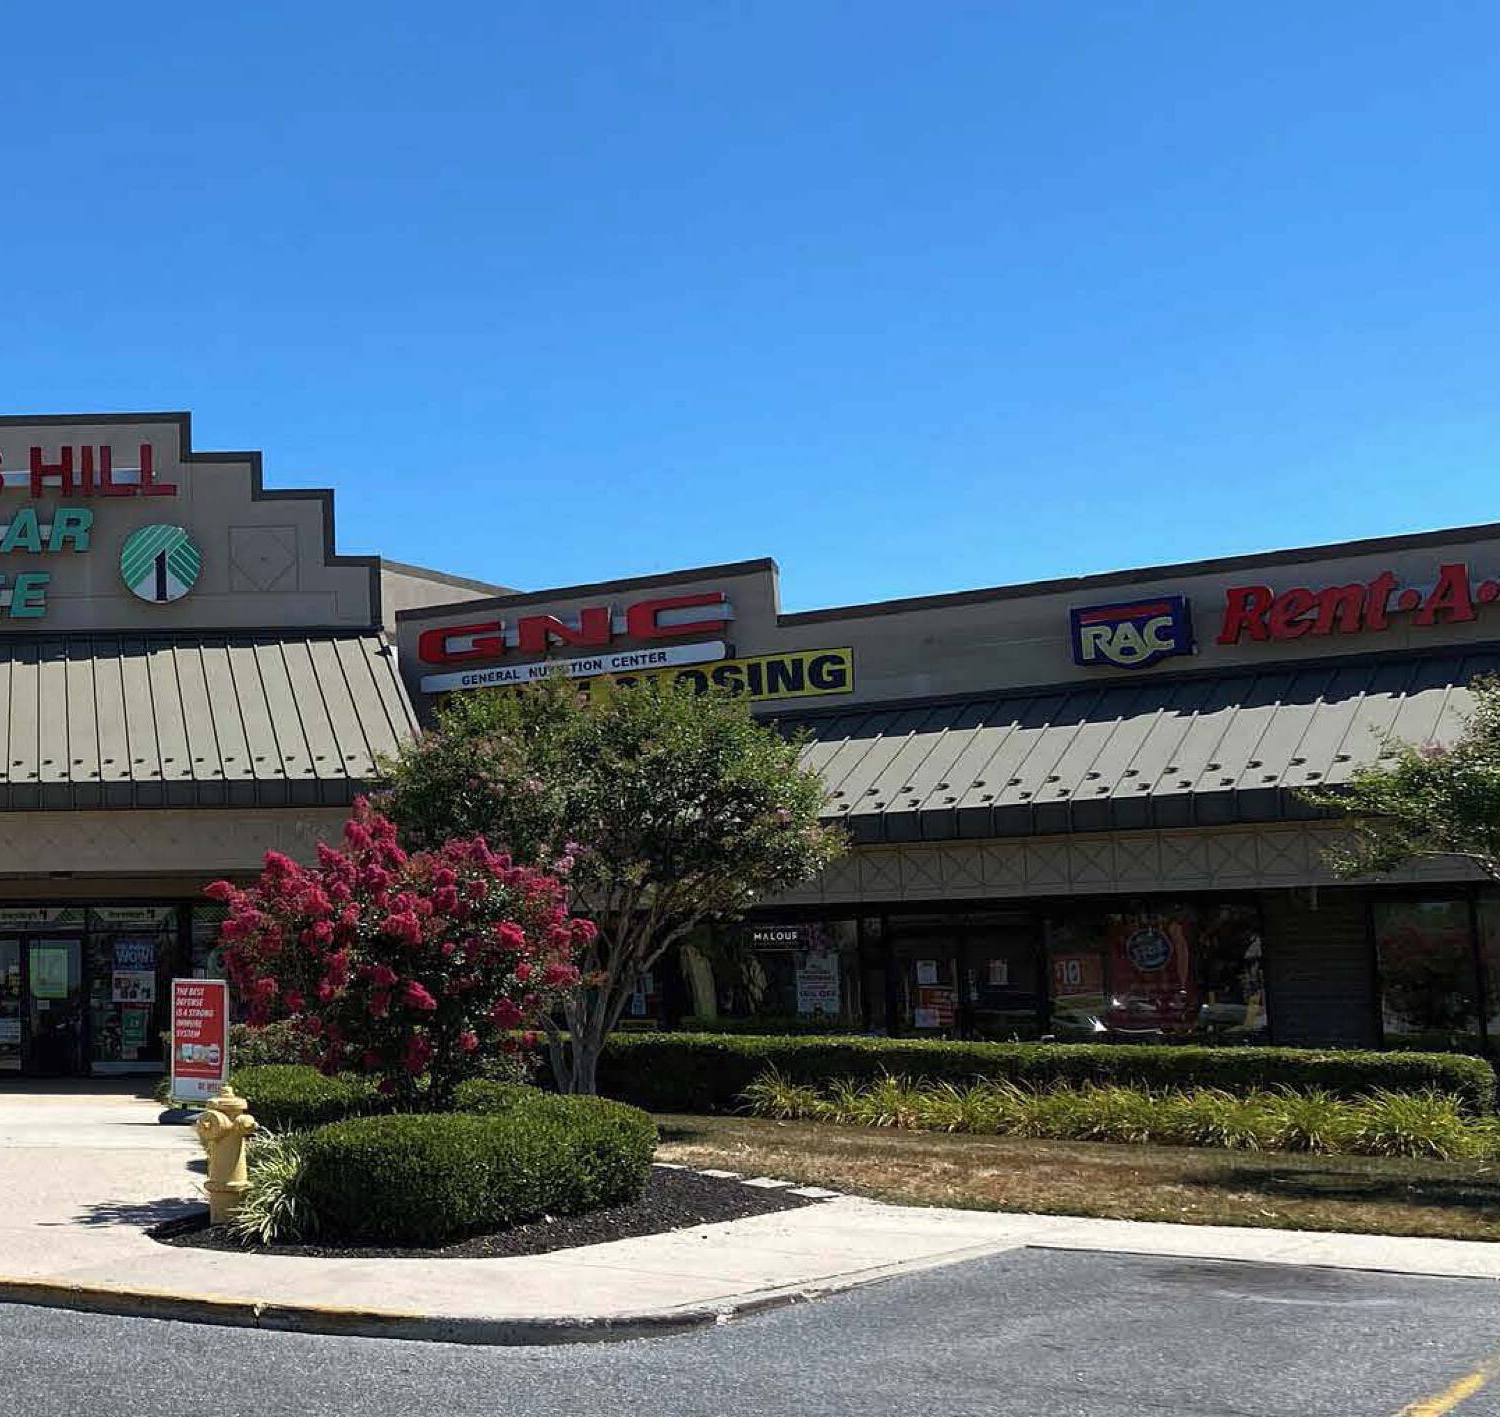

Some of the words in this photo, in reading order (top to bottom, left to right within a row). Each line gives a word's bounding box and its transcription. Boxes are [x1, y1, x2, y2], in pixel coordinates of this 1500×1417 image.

[30, 444, 177, 498] HILL
[418, 591, 728, 665] GNC
[1080, 616, 1175, 663] RAC
[461, 670, 522, 687] GENERAL
[528, 658, 603, 681] NUTION
[610, 650, 668, 670] CENTER
[617, 654, 850, 703] OSING
